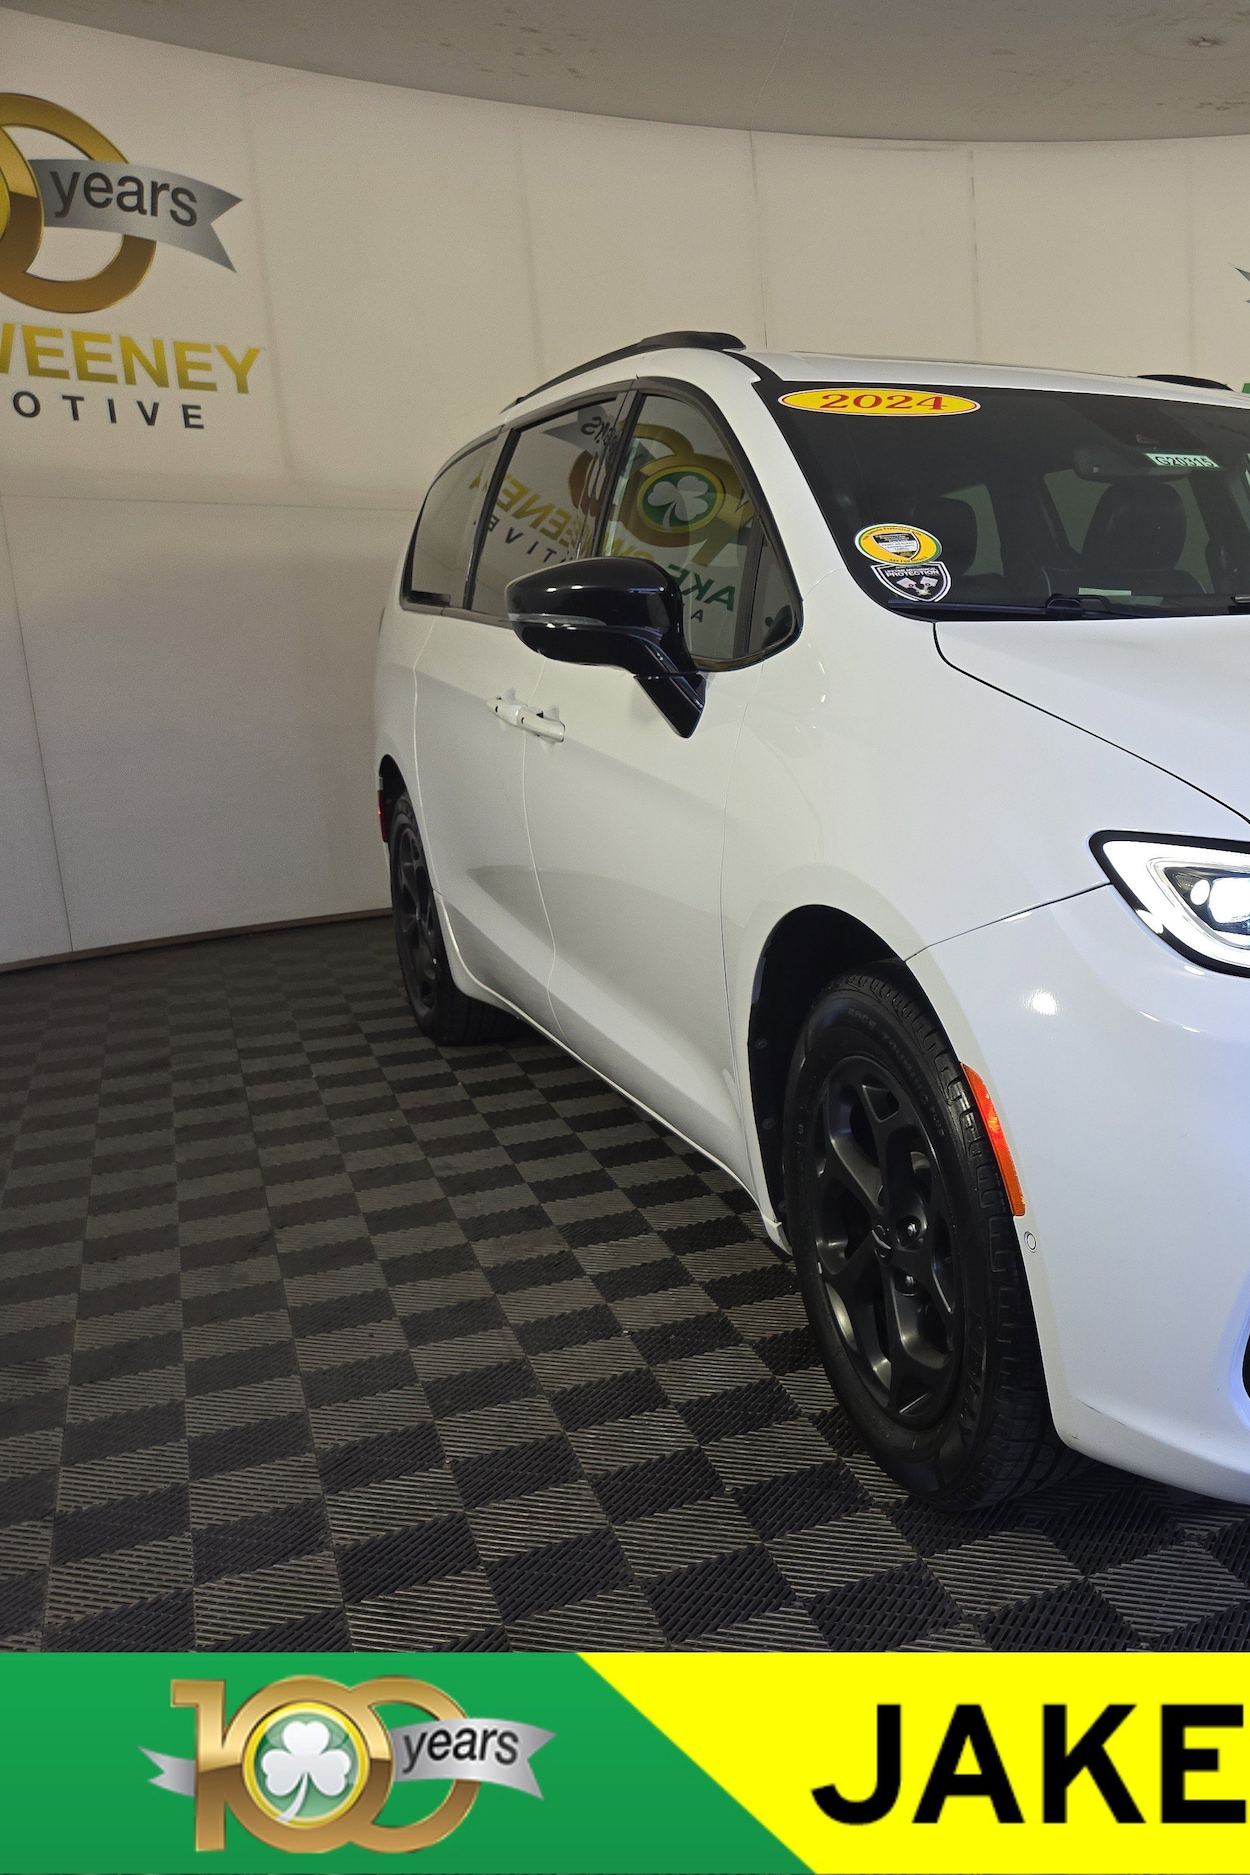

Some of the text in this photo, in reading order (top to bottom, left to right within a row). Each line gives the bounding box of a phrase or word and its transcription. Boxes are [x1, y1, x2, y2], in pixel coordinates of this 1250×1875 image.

[49, 169, 198, 228] years
[0, 322, 261, 395] EENEY
[12, 390, 205, 430] OTIVE
[819, 393, 949, 411] 2024
